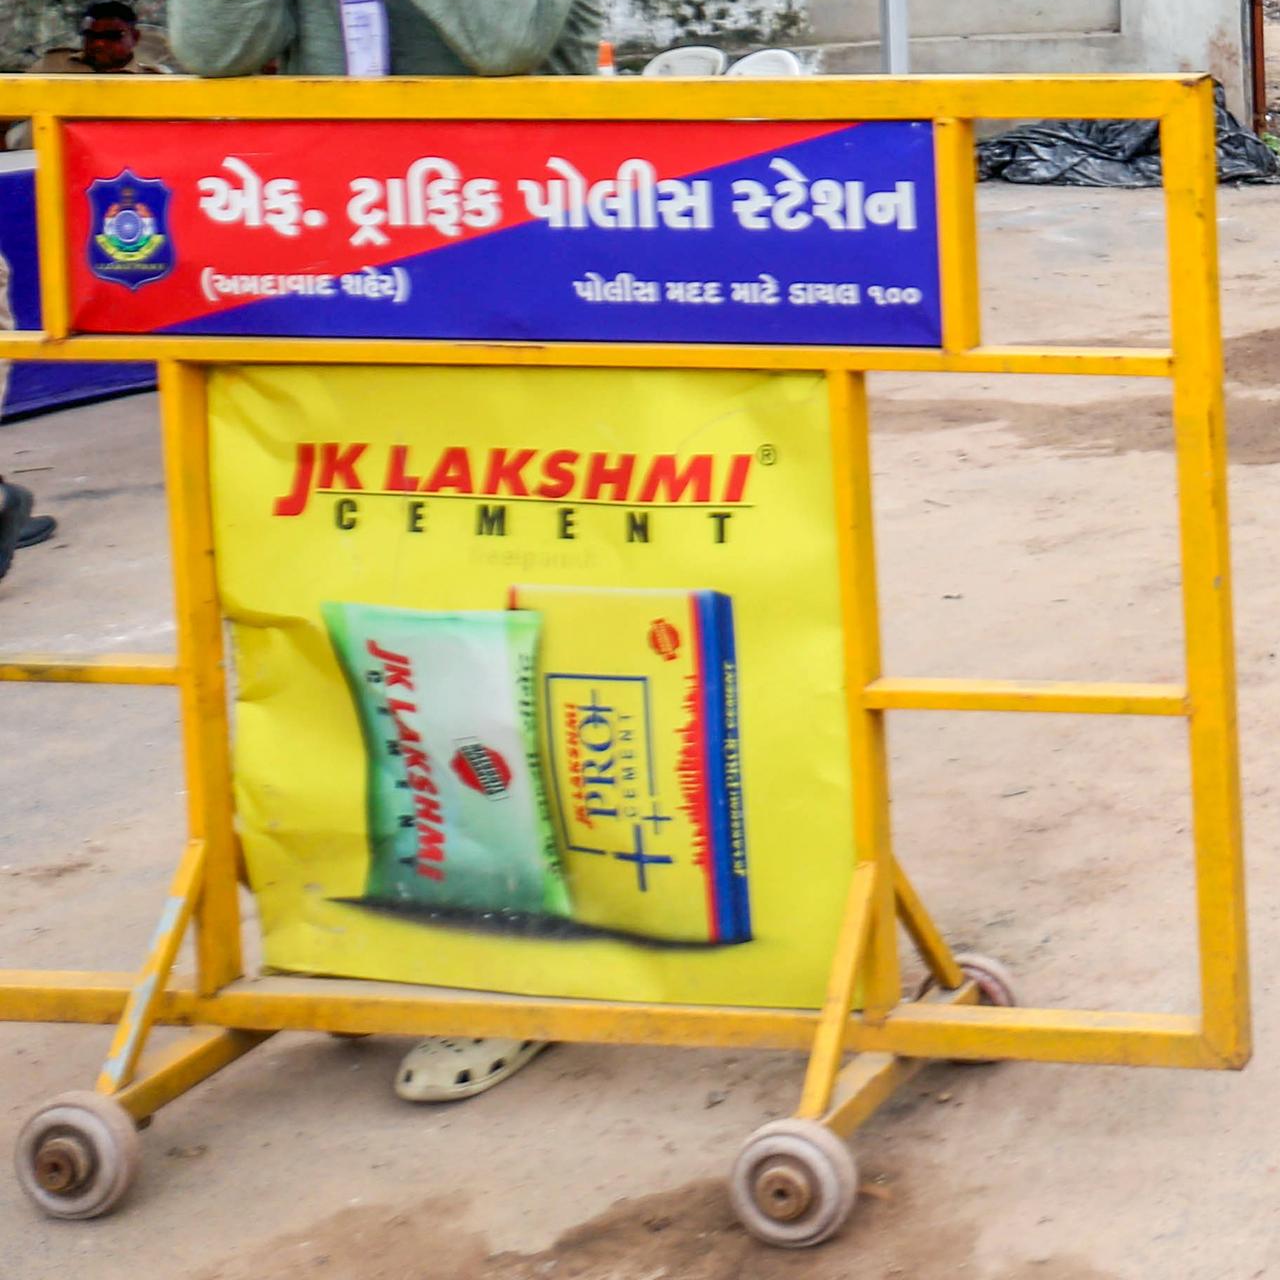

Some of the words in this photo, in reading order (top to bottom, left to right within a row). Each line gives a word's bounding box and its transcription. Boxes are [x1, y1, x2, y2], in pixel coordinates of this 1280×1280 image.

[197, 156, 327, 237] એફ.
[347, 156, 503, 247] ટ્રાફિક
[517, 157, 714, 230] પોલીસ
[731, 157, 917, 231] સ્ટેશન
[572, 271, 660, 304] પોલીસ
[665, 280, 725, 304] મદદ
[731, 273, 782, 305] માટે
[867, 284, 923, 306] ૧૦૦
[273, 442, 368, 517] JK
[334, 498, 732, 545] CEMENT
[365, 638, 416, 692] JK
[386, 697, 448, 883] LAKSHMI
